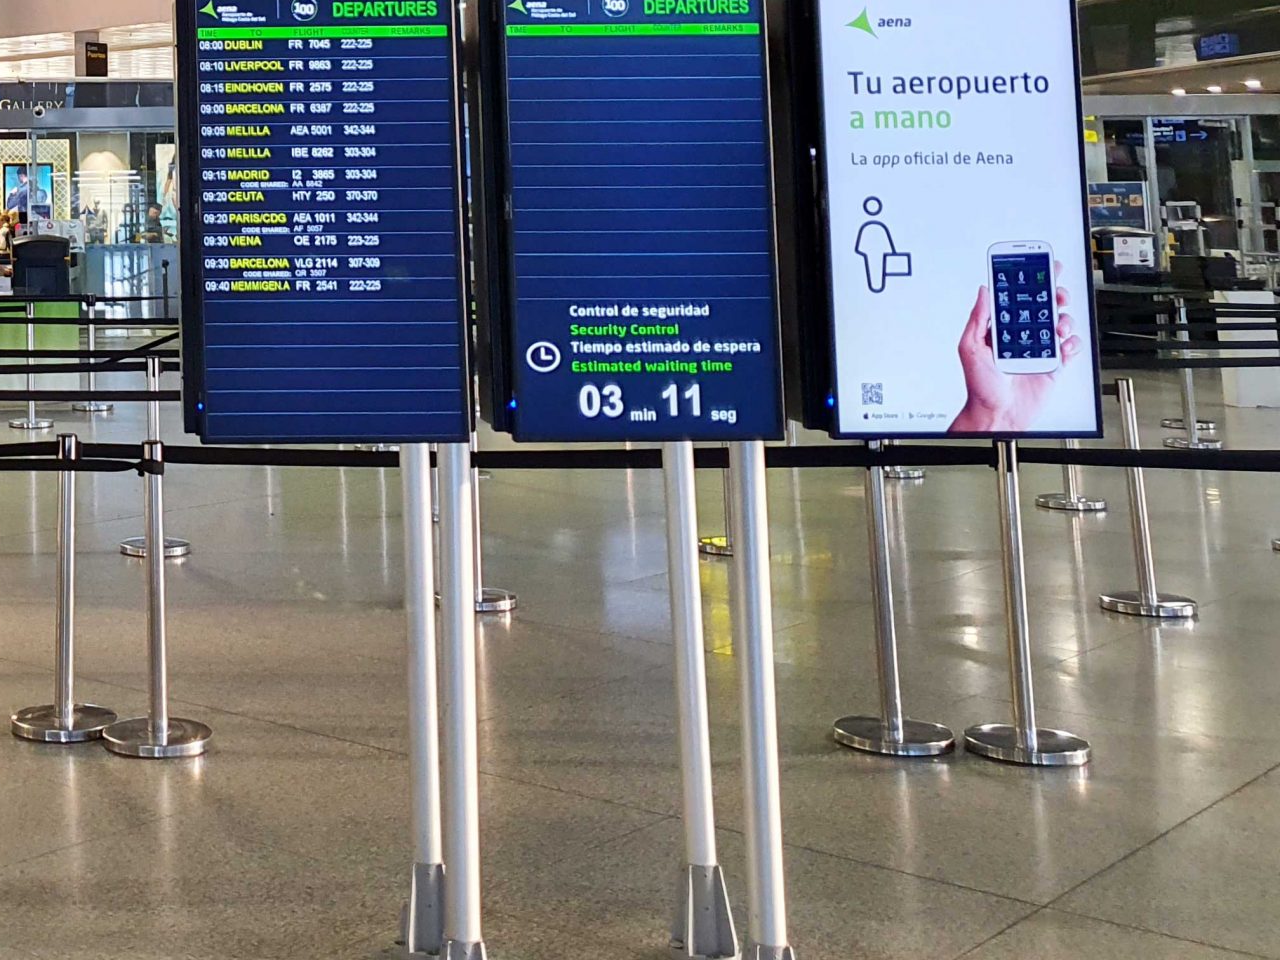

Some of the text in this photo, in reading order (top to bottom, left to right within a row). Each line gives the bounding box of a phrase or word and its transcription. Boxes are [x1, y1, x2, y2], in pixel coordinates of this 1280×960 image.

[294, 0, 438, 18] 100 DEPARTURES
[878, 16, 912, 28] aena
[224, 40, 263, 50] DUBLIN
[225, 61, 284, 71] LIVERPOOL
[225, 82, 283, 92] EINDHOVEN
[848, 71, 1049, 100] Tu aeropuerto
[226, 104, 284, 114] BARCELONA
[850, 110, 952, 129] a mano
[226, 126, 270, 136] MELILLA
[852, 152, 1013, 168] La app oficial de Aena
[228, 170, 269, 180] MADRID
[228, 192, 264, 202] CEUTA
[229, 213, 287, 224] PARIS/CDG
[204, 236, 262, 246] 09:30 VIENA
[570, 304, 709, 318] Control de seguridad
[570, 324, 678, 337] Security Control
[571, 341, 760, 355] Tiempo estimado de espera
[572, 360, 732, 374] Estimated waiting time
[579, 384, 737, 423] 03 min 11 seg
